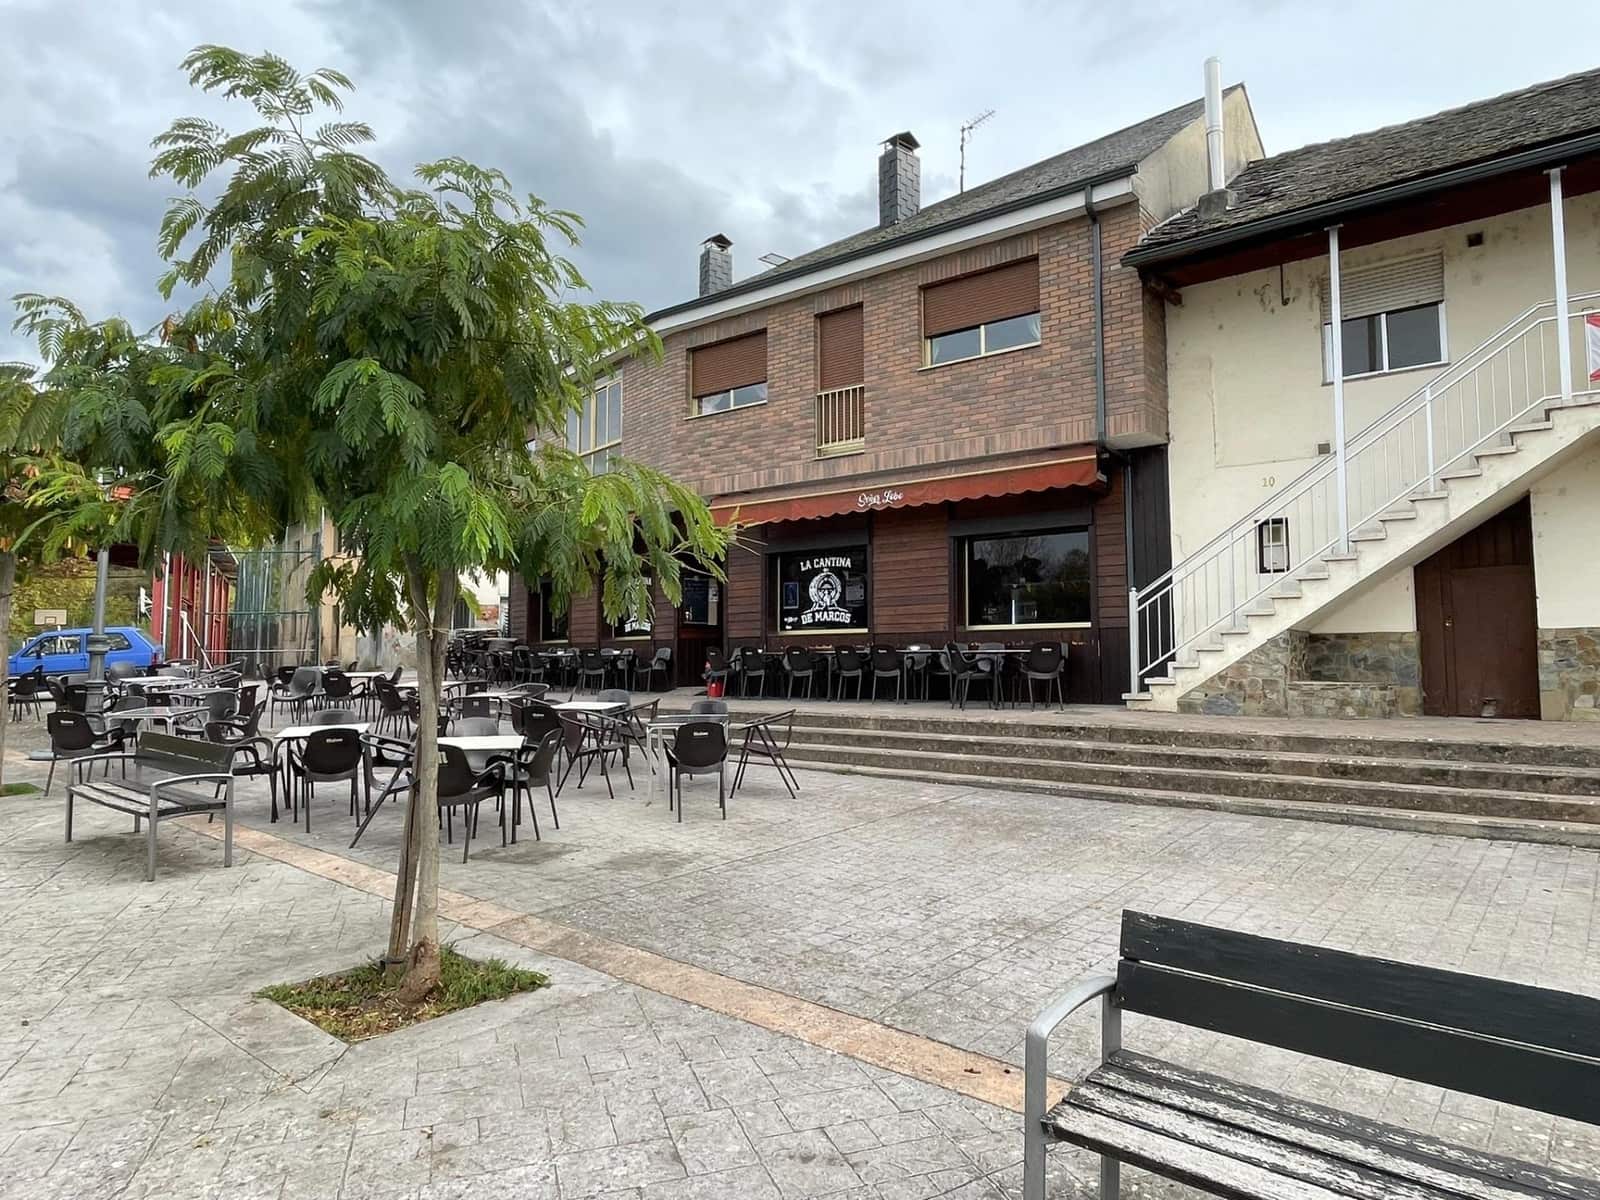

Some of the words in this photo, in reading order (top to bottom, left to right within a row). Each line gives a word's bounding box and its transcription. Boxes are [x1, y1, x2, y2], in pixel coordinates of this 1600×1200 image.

[800, 560, 812, 571] LA
[813, 557, 852, 568] CANTINA
[801, 613, 813, 625] DE
[814, 611, 852, 624] MARCOS
